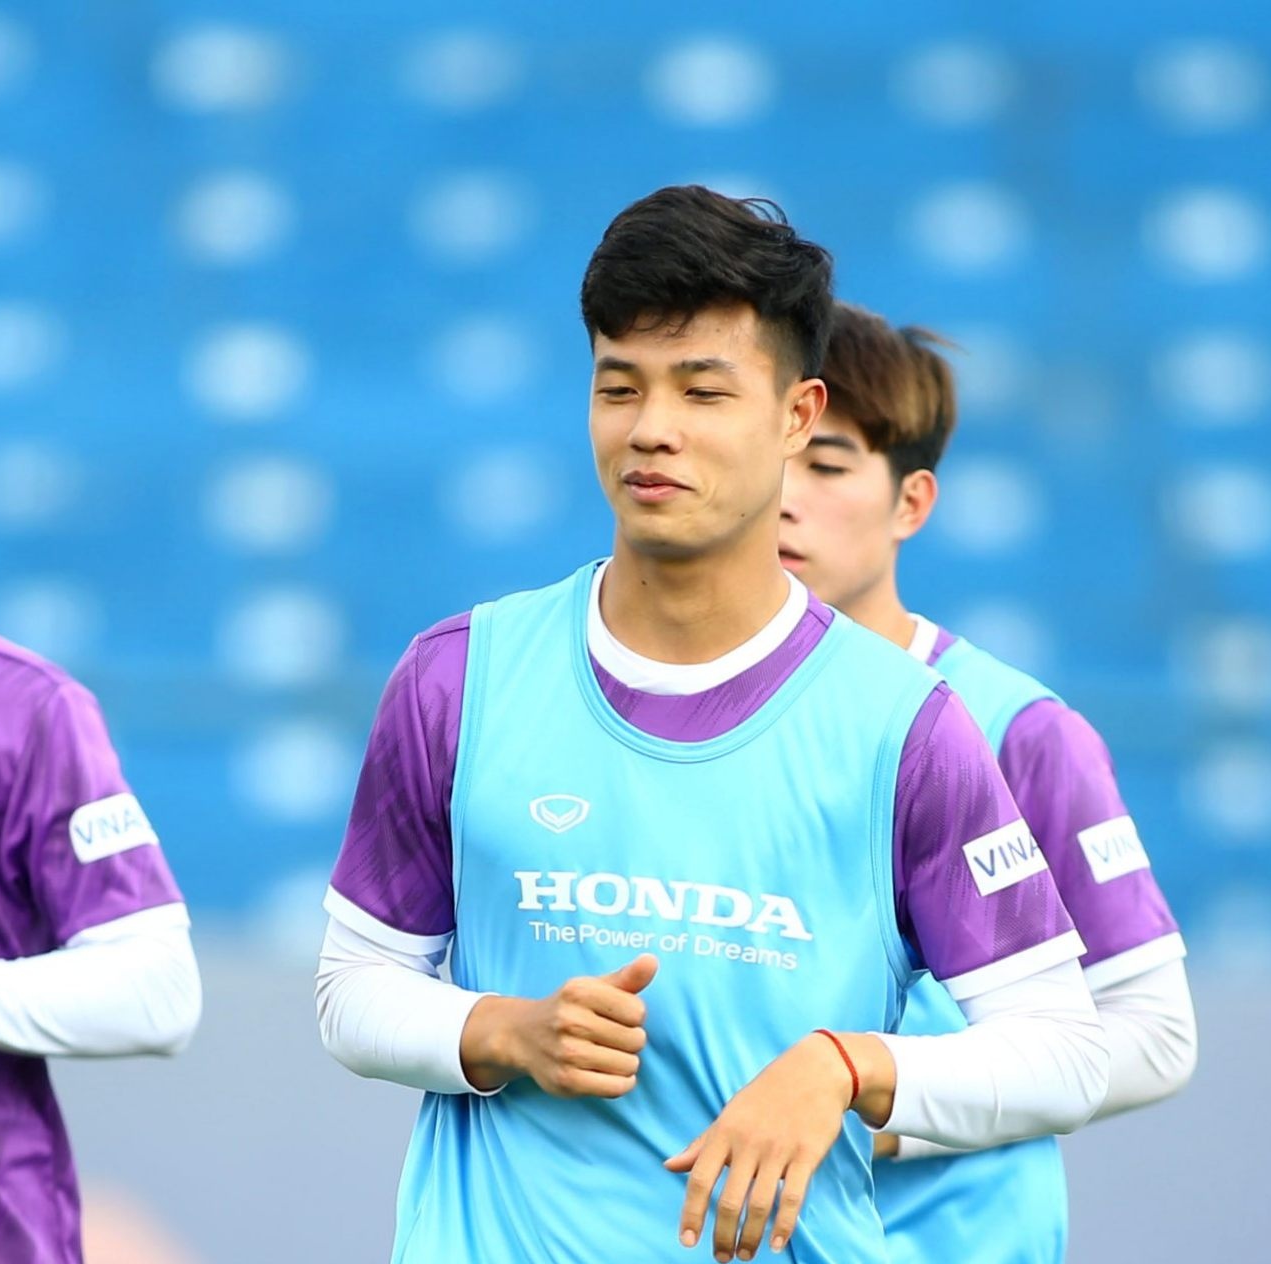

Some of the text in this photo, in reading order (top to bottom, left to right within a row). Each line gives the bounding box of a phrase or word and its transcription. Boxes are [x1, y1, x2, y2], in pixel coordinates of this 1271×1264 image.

[513, 871, 813, 941] HONDA
[528, 921, 799, 971] The Power of Dreams
